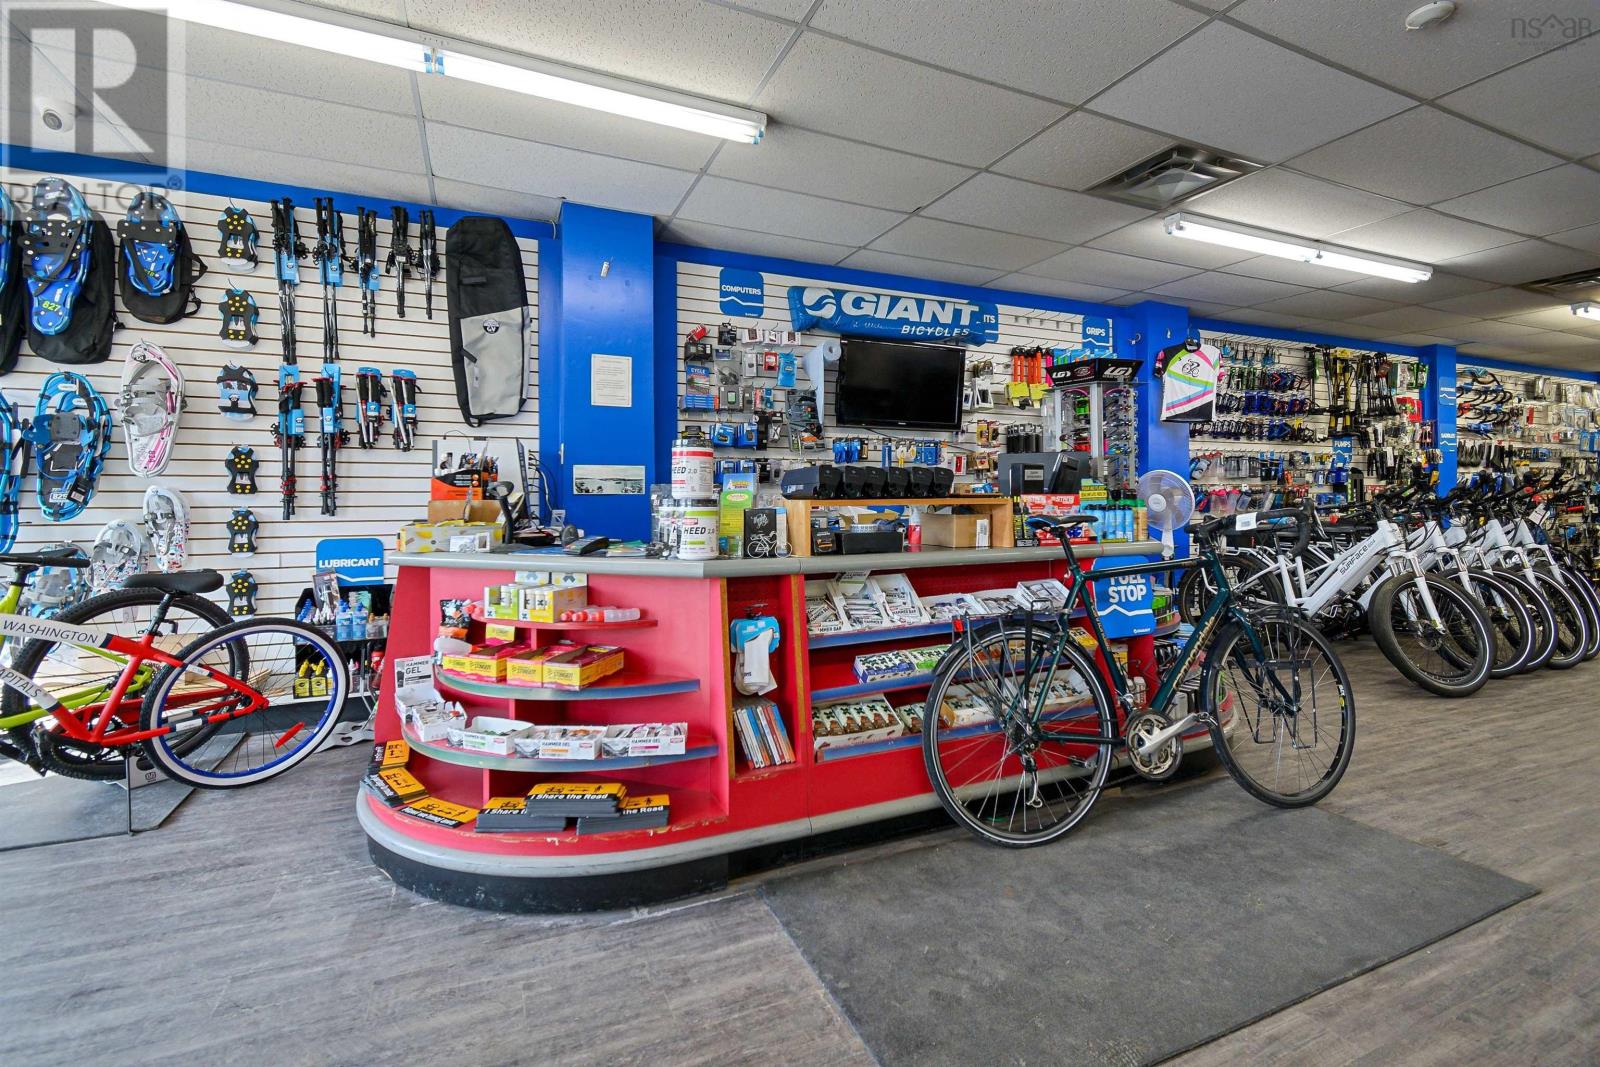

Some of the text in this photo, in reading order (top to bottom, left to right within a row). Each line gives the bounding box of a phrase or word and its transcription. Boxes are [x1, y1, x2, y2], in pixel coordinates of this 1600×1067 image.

[721, 284, 762, 296] COMPUTERS
[840, 291, 980, 326] GIANT
[983, 314, 996, 323] ITS
[1086, 326, 1106, 336] GRIPS
[1334, 440, 1351, 448] PUMPS
[672, 466, 687, 475] EED
[683, 526, 706, 535] HEED
[319, 557, 381, 569] LUBRICANT
[1108, 584, 1147, 604] STOP
[3, 619, 99, 644] WASHINGTON
[405, 666, 422, 675] GEL
[0, 668, 41, 698] APITALS
[536, 792, 564, 800] Share
[584, 792, 609, 800] Road
[639, 804, 664, 812] Road
